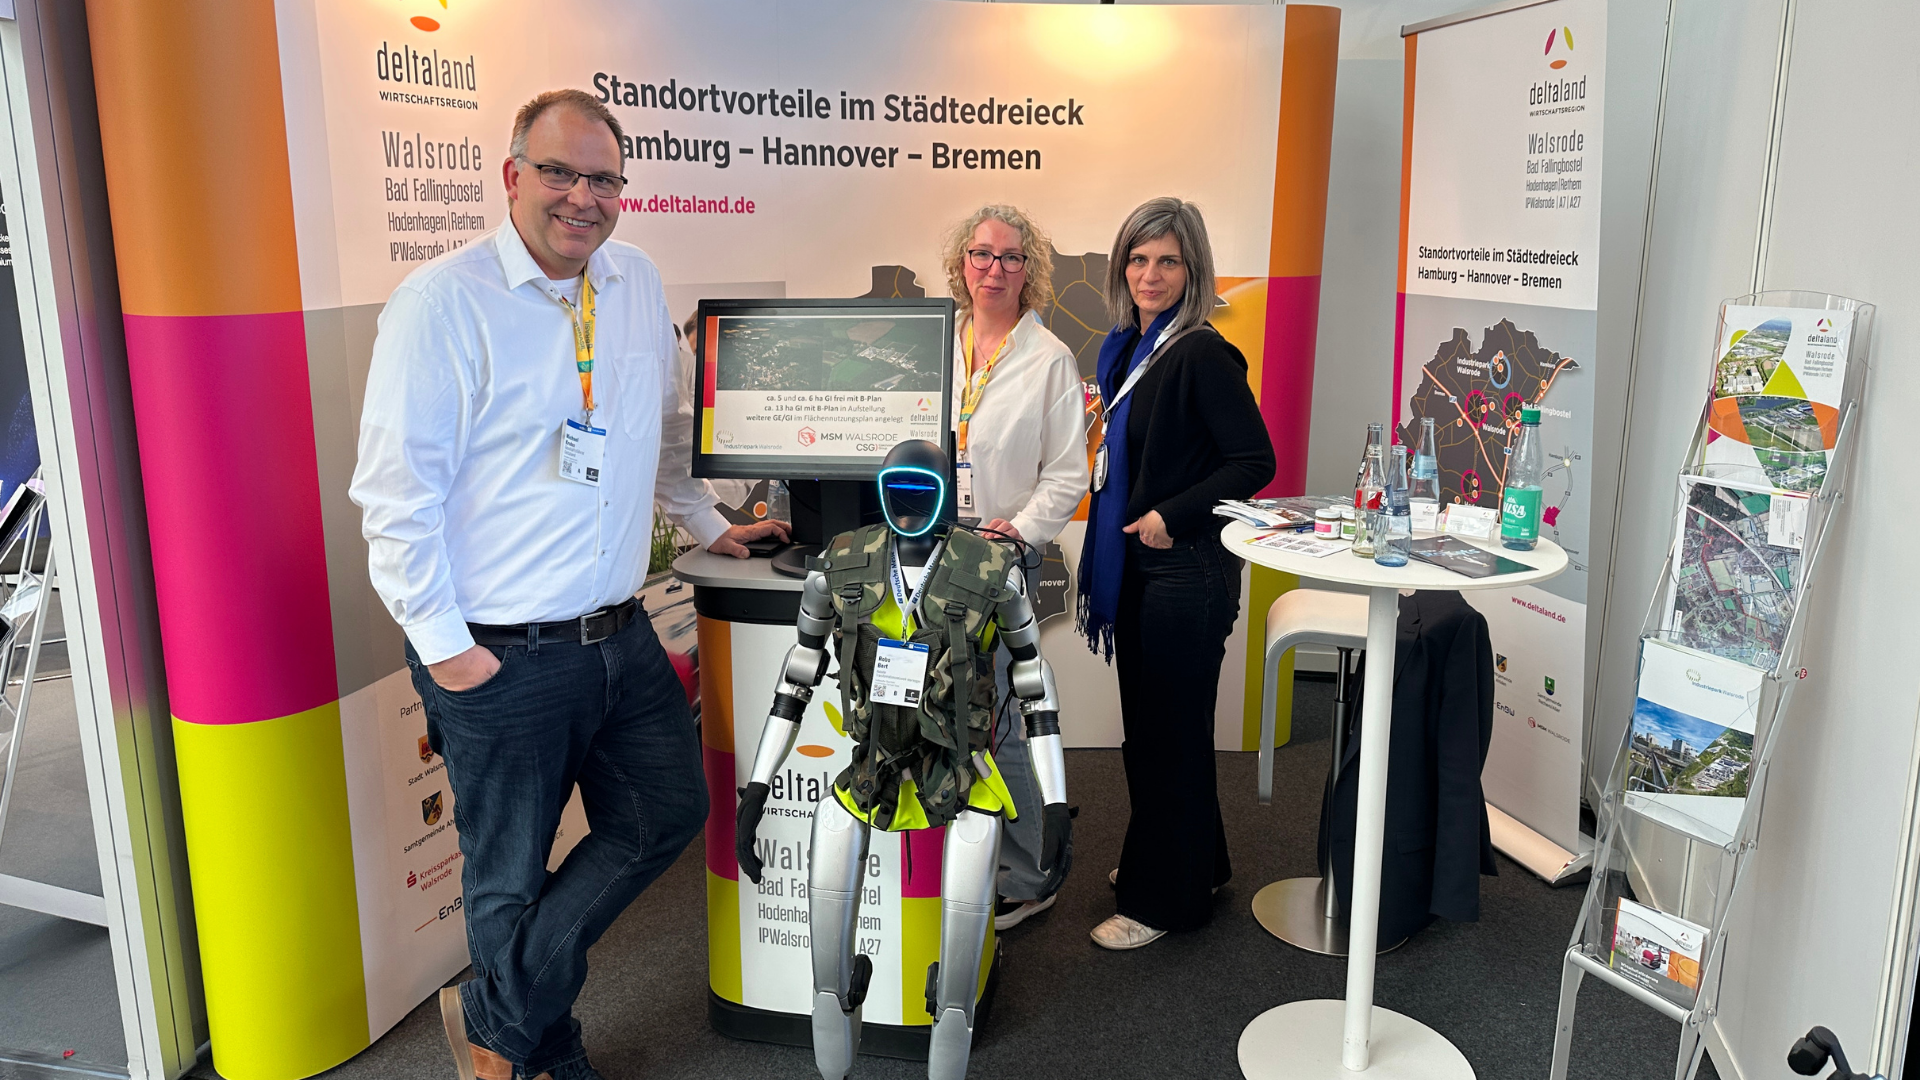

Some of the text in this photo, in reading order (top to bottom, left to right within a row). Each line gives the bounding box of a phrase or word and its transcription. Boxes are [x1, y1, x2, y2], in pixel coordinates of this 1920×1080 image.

[377, 41, 476, 92] deltaland
[379, 90, 478, 110] WIRTSCHAFTSREGION
[593, 72, 1084, 126] Standortvorteile im Städtedreieck
[1530, 75, 1586, 105] deltaland
[1529, 105, 1585, 117] WIRTSCHAFTSREGION
[382, 131, 482, 171] Walsrode
[622, 130, 730, 168] amburg
[763, 136, 899, 168] Hannover
[932, 142, 1041, 170] Bremen
[1528, 129, 1583, 154] Walsrode
[1526, 157, 1583, 174] Bad Fallingbostel
[385, 177, 483, 205] Bad Fallingbostel
[620, 194, 755, 214] ww.deltaland.de
[1525, 196, 1555, 208] IPWalsrode
[390, 240, 444, 261] IPWalsrode
[1419, 245, 1579, 266] Standortvorteile im Städtedreieck
[1418, 266, 1457, 283] Hamburg
[1467, 269, 1511, 285] Hannover
[1521, 273, 1562, 289] Bremen
[1807, 334, 1837, 344] deltaland
[1457, 357, 1491, 369] Industriepark
[1805, 351, 1835, 360] Walsrode
[1457, 366, 1481, 377] Walsrode
[804, 415, 873, 423] Flächennutzungsplan
[875, 415, 904, 424] angelegt
[848, 405, 885, 413] Aufstellung
[910, 414, 938, 422] deltaland
[820, 433, 898, 442] MSM WALSRODE
[1482, 423, 1506, 436] Walsrode
[892, 570, 903, 597] Deutsche
[1511, 596, 1566, 623] www.deltaland.de
[400, 701, 423, 718] Partn
[1496, 701, 1515, 717] EnBW
[408, 762, 445, 786] Stadt Walsro
[403, 824, 445, 854] Samtgemeinde
[419, 851, 462, 880] Kreissparkas
[420, 868, 452, 892] Walsrode
[758, 876, 783, 897] Bad
[438, 896, 463, 920] EnB
[758, 903, 808, 924] Hodenha
[759, 927, 881, 955] IPWalsro A27
